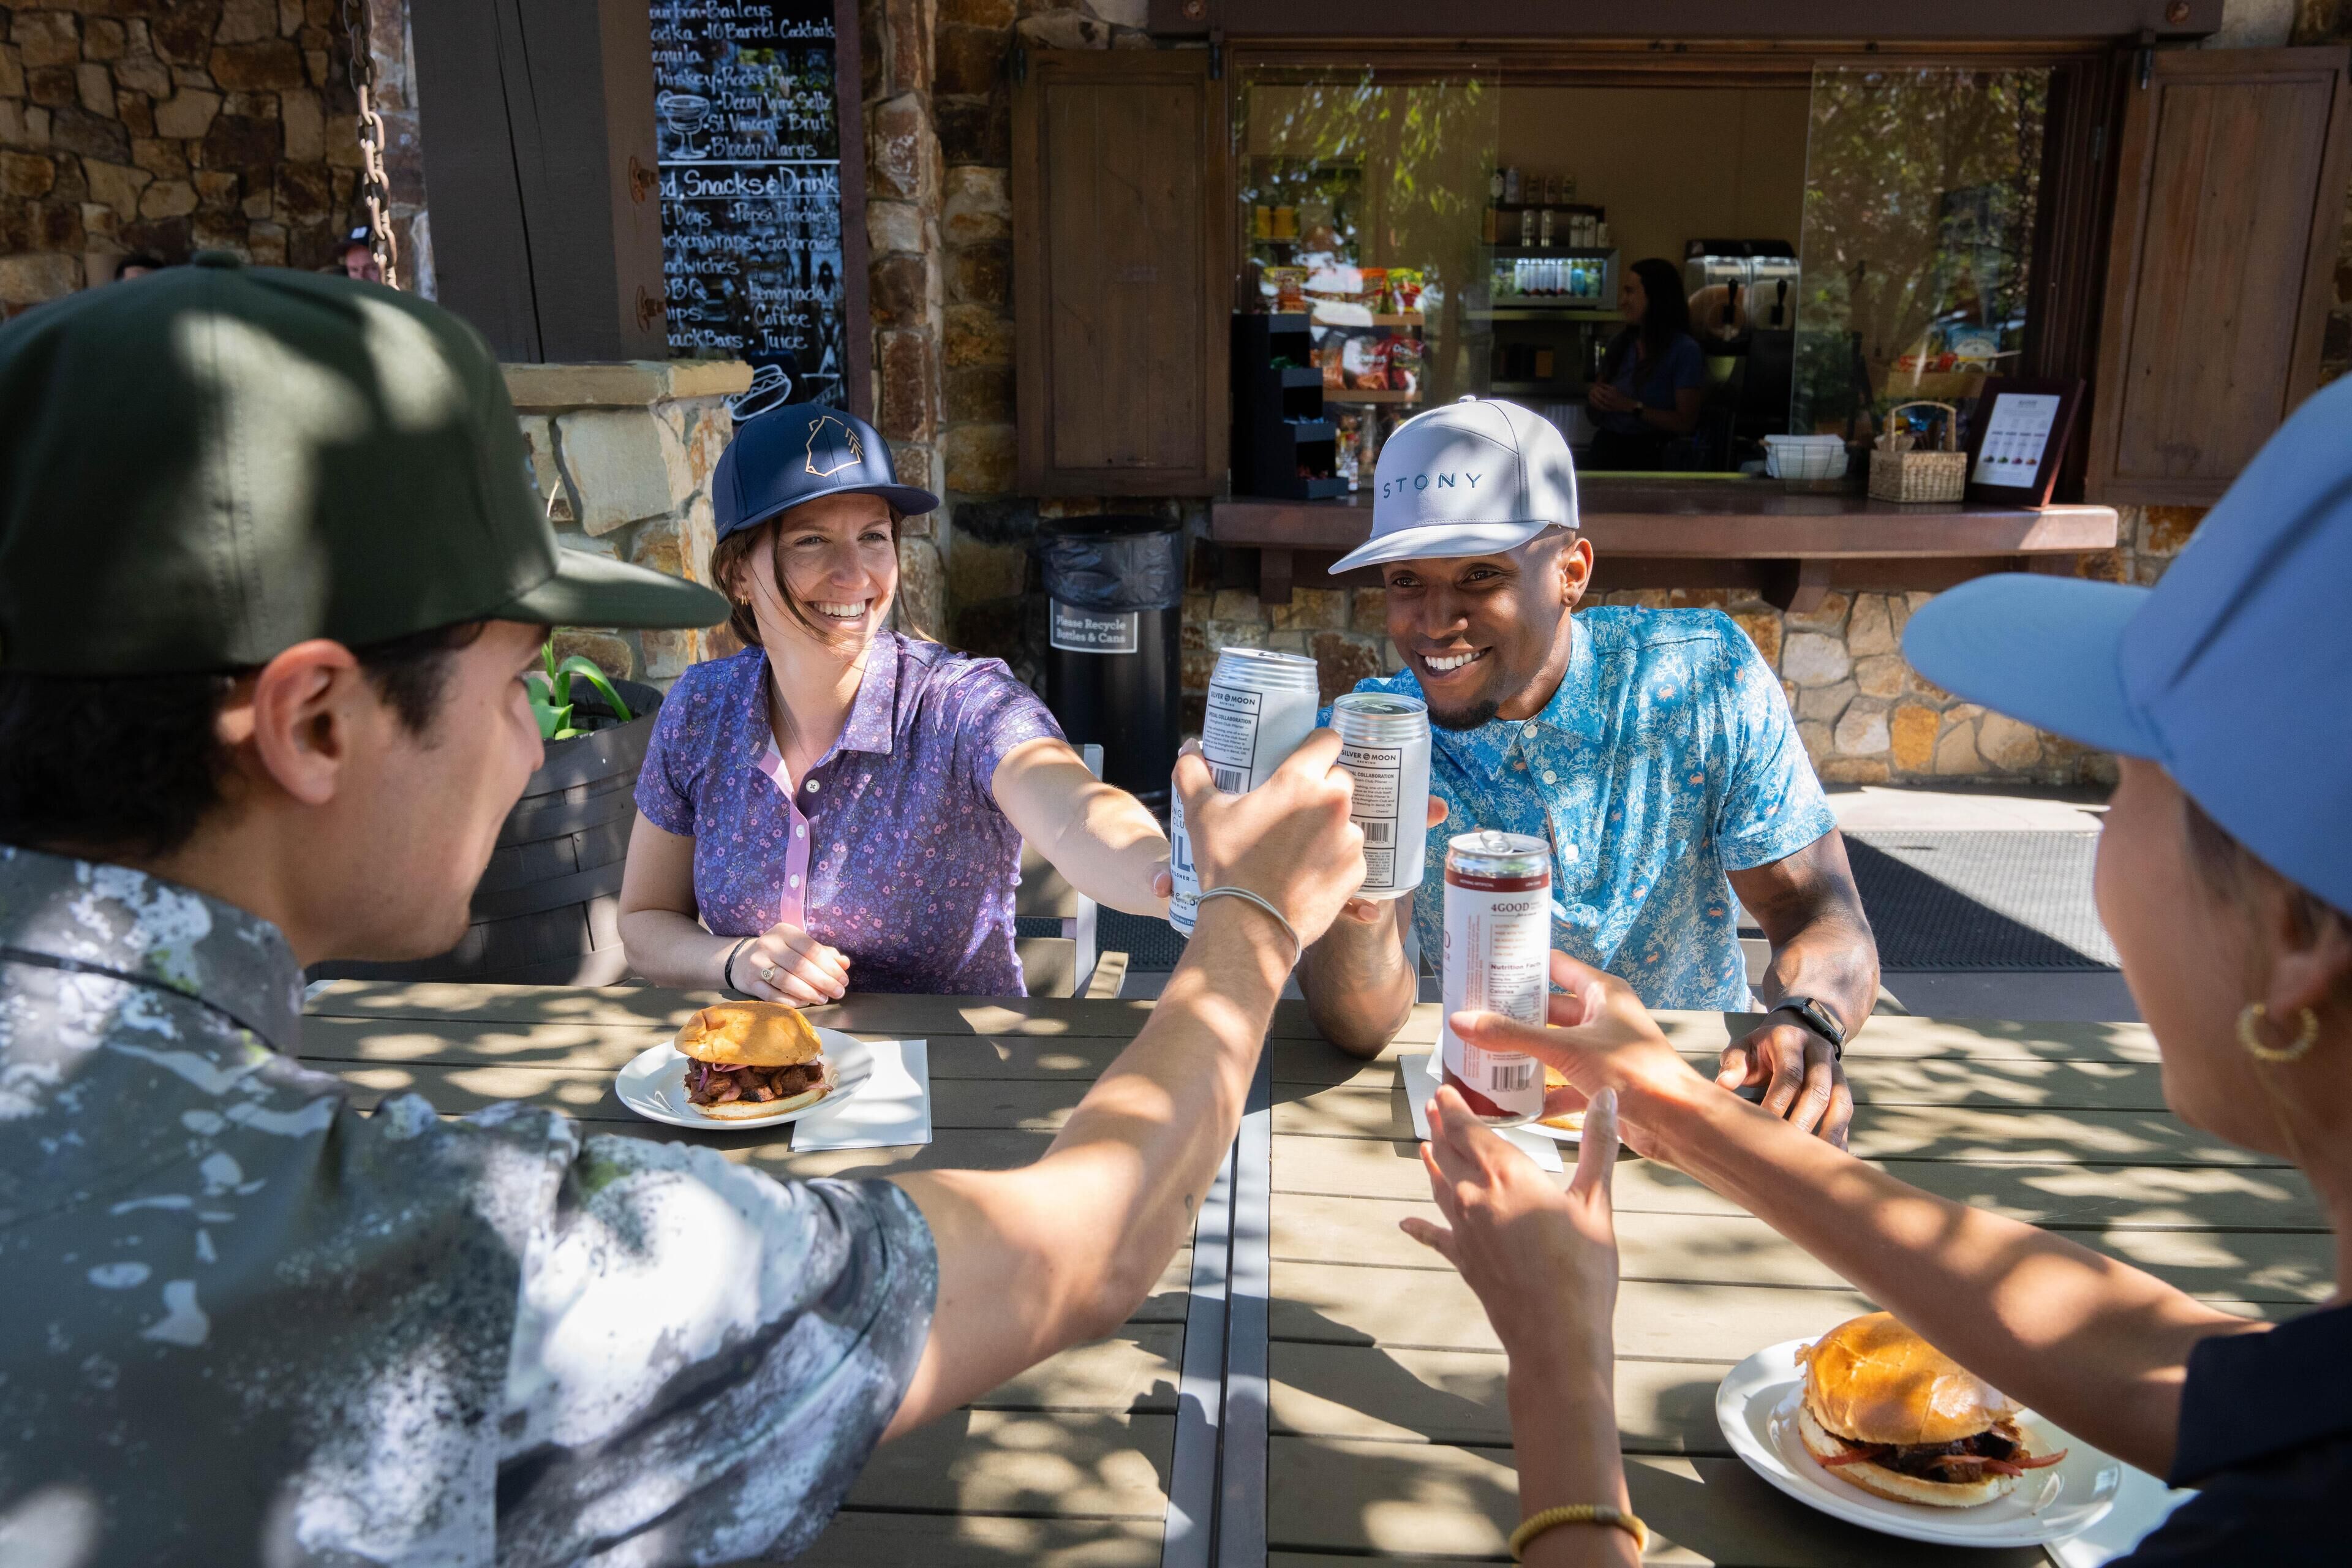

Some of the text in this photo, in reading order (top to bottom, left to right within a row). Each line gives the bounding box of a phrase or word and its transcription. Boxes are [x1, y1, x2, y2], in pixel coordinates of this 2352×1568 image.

[706, 0, 773, 26] Baileys
[650, 24, 698, 42] odka
[707, 17, 835, 39] 10 Barrel Cocktails
[652, 43, 704, 71] equila
[654, 67, 716, 96] hiskey
[788, 113, 829, 131] Brut
[711, 134, 818, 160] Bloody Marys
[684, 168, 765, 197] Snacks
[674, 203, 712, 235] Dogs
[734, 202, 773, 227] Pepsi
[664, 256, 740, 275] ndwiches
[666, 306, 703, 330] ips
[754, 303, 812, 327] Coffee
[703, 328, 744, 349] Bars
[760, 329, 809, 356] Juice
[1383, 472, 1483, 499] STONY
[1056, 614, 1126, 632] Please Recycle
[1056, 628, 1126, 643] Bottles & Cans
[1231, 696, 1255, 705] MOON
[1218, 714, 1251, 725] COLLABORATION
[1341, 749, 1362, 759] SILVER
[1172, 816, 1185, 829] CLU
[1490, 902, 1529, 912] 4GOOD
